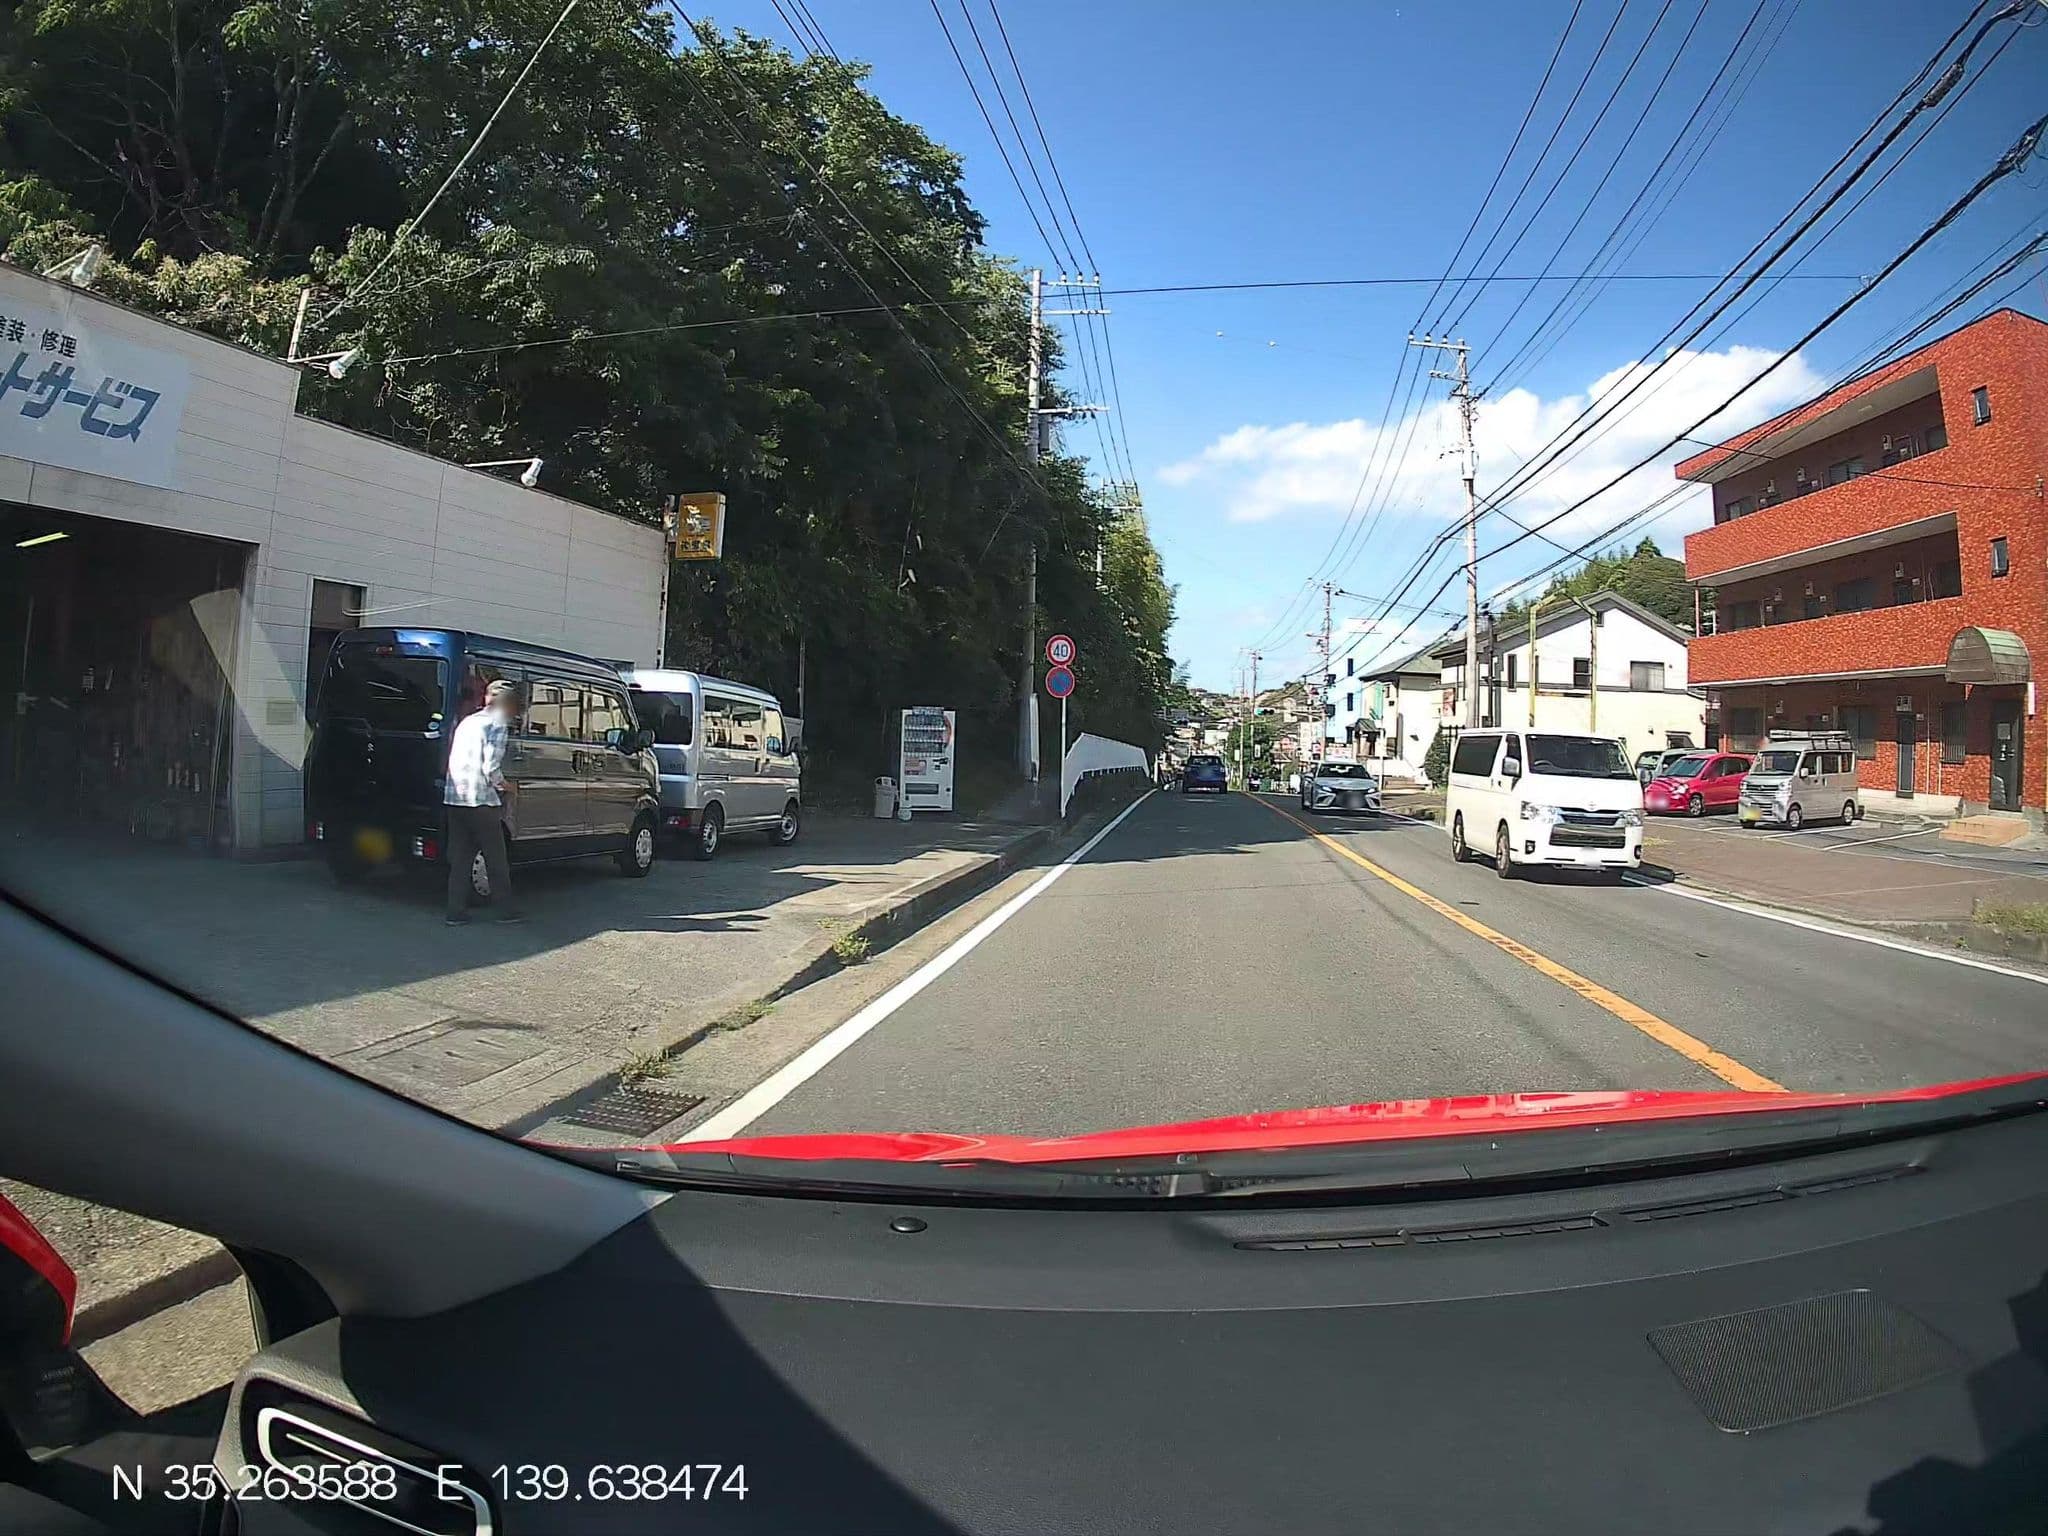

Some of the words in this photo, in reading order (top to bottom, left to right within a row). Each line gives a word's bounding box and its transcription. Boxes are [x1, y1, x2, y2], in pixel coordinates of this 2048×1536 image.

[0, 351, 161, 443] トサービス
[1053, 643, 1069, 658] 40
